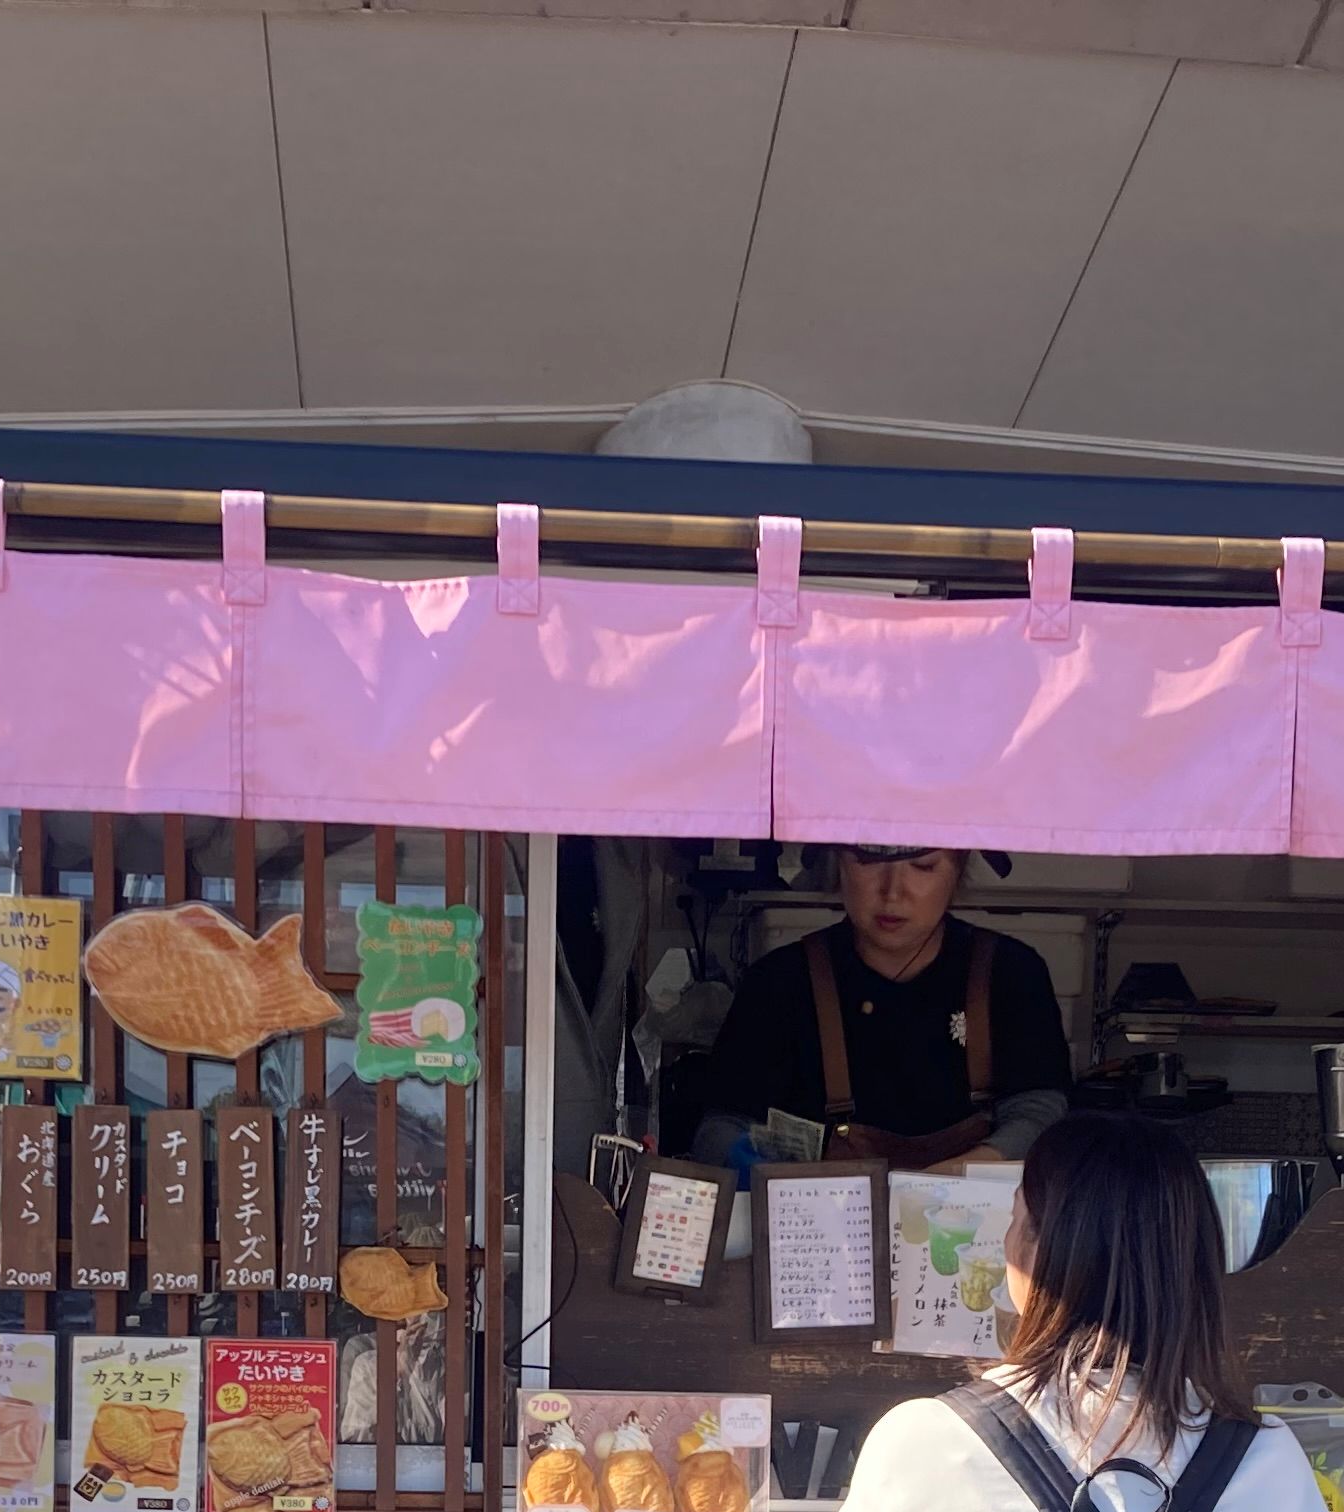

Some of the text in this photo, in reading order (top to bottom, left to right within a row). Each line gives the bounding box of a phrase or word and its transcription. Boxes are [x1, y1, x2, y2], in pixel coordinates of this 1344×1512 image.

[113, 1121, 128, 1194] カスタード
[161, 1130, 187, 1204] チョコ
[17, 1134, 40, 1225] おぐら
[89, 1124, 111, 1225] クリーム
[229, 1120, 267, 1264] ベーコンチーズ
[298, 1113, 327, 1263] 牛すじ黒カレー
[6, 1268, 52, 1286] 200円
[77, 1267, 127, 1287] 250円
[152, 1273, 198, 1290] 250円
[225, 1267, 275, 1286] 280円
[286, 1272, 333, 1292] 280円
[215, 1348, 327, 1365] アップルデニッシュ
[92, 1369, 183, 1388] カスタード
[237, 1364, 306, 1382] たいやき
[103, 1387, 171, 1404] ショコラ
